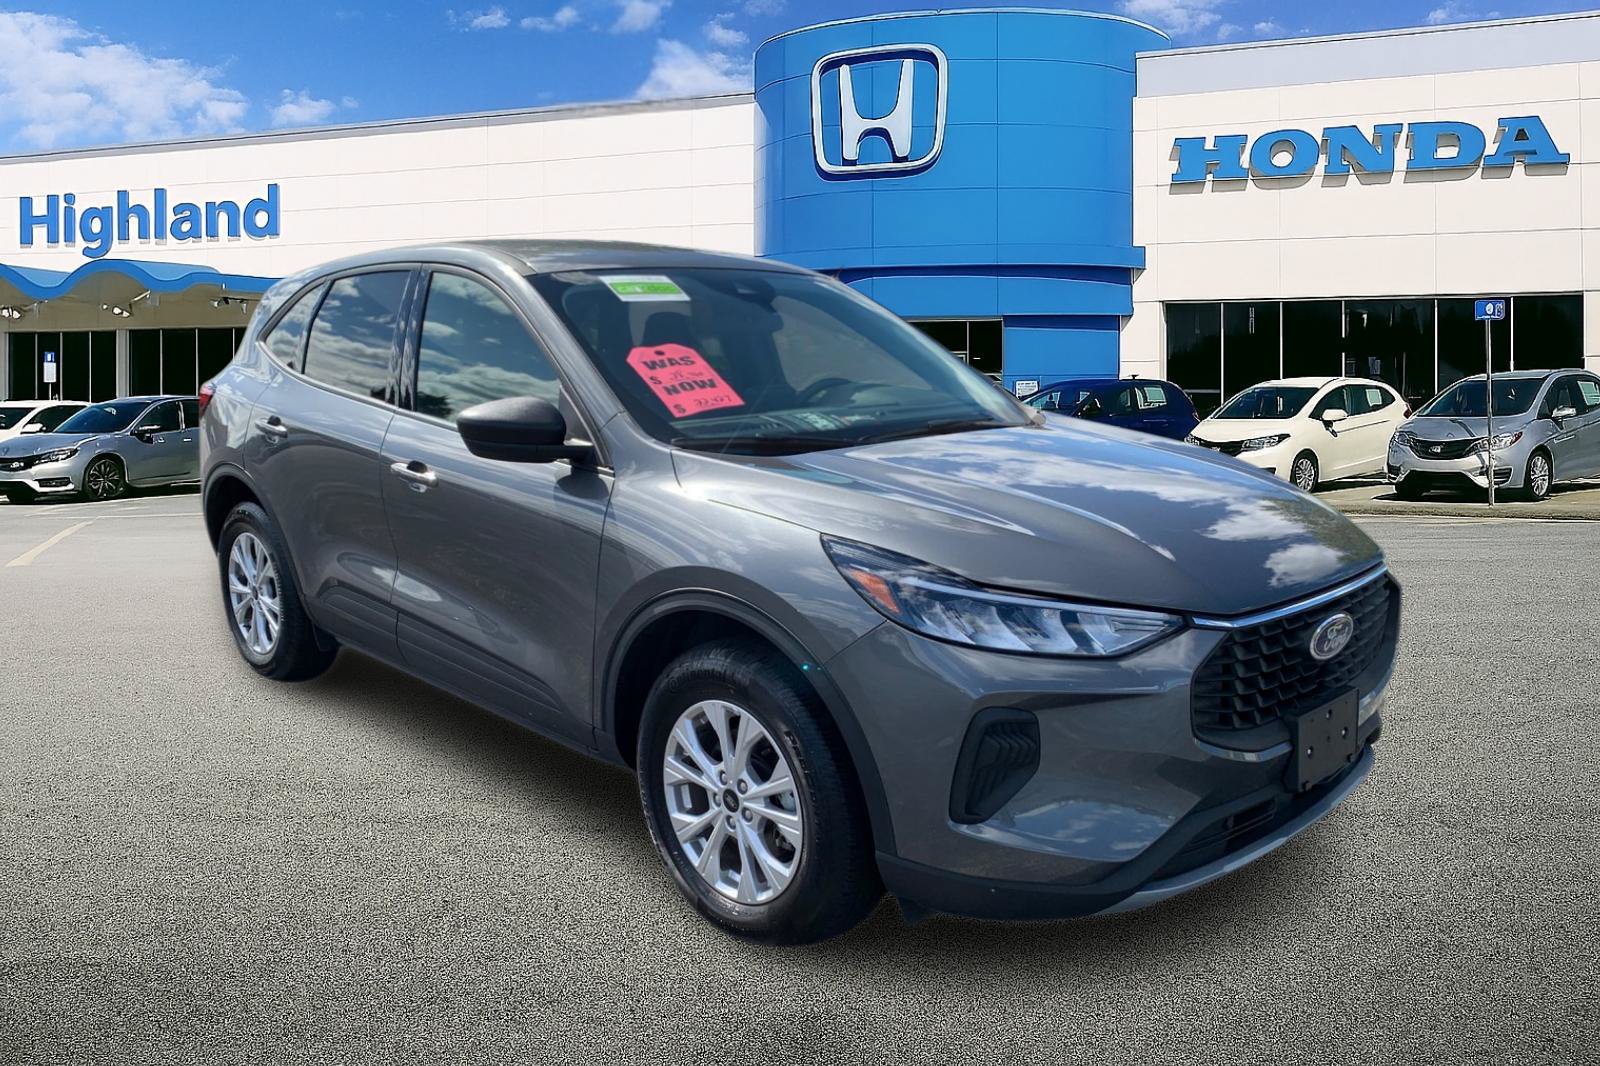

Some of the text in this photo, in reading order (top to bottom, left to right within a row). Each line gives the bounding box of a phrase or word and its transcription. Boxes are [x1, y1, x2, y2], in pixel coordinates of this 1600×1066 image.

[1170, 115, 1571, 184] HONDA
[19, 183, 280, 259] Highland
[641, 355, 696, 371] WAS
[663, 377, 718, 396] NOW
